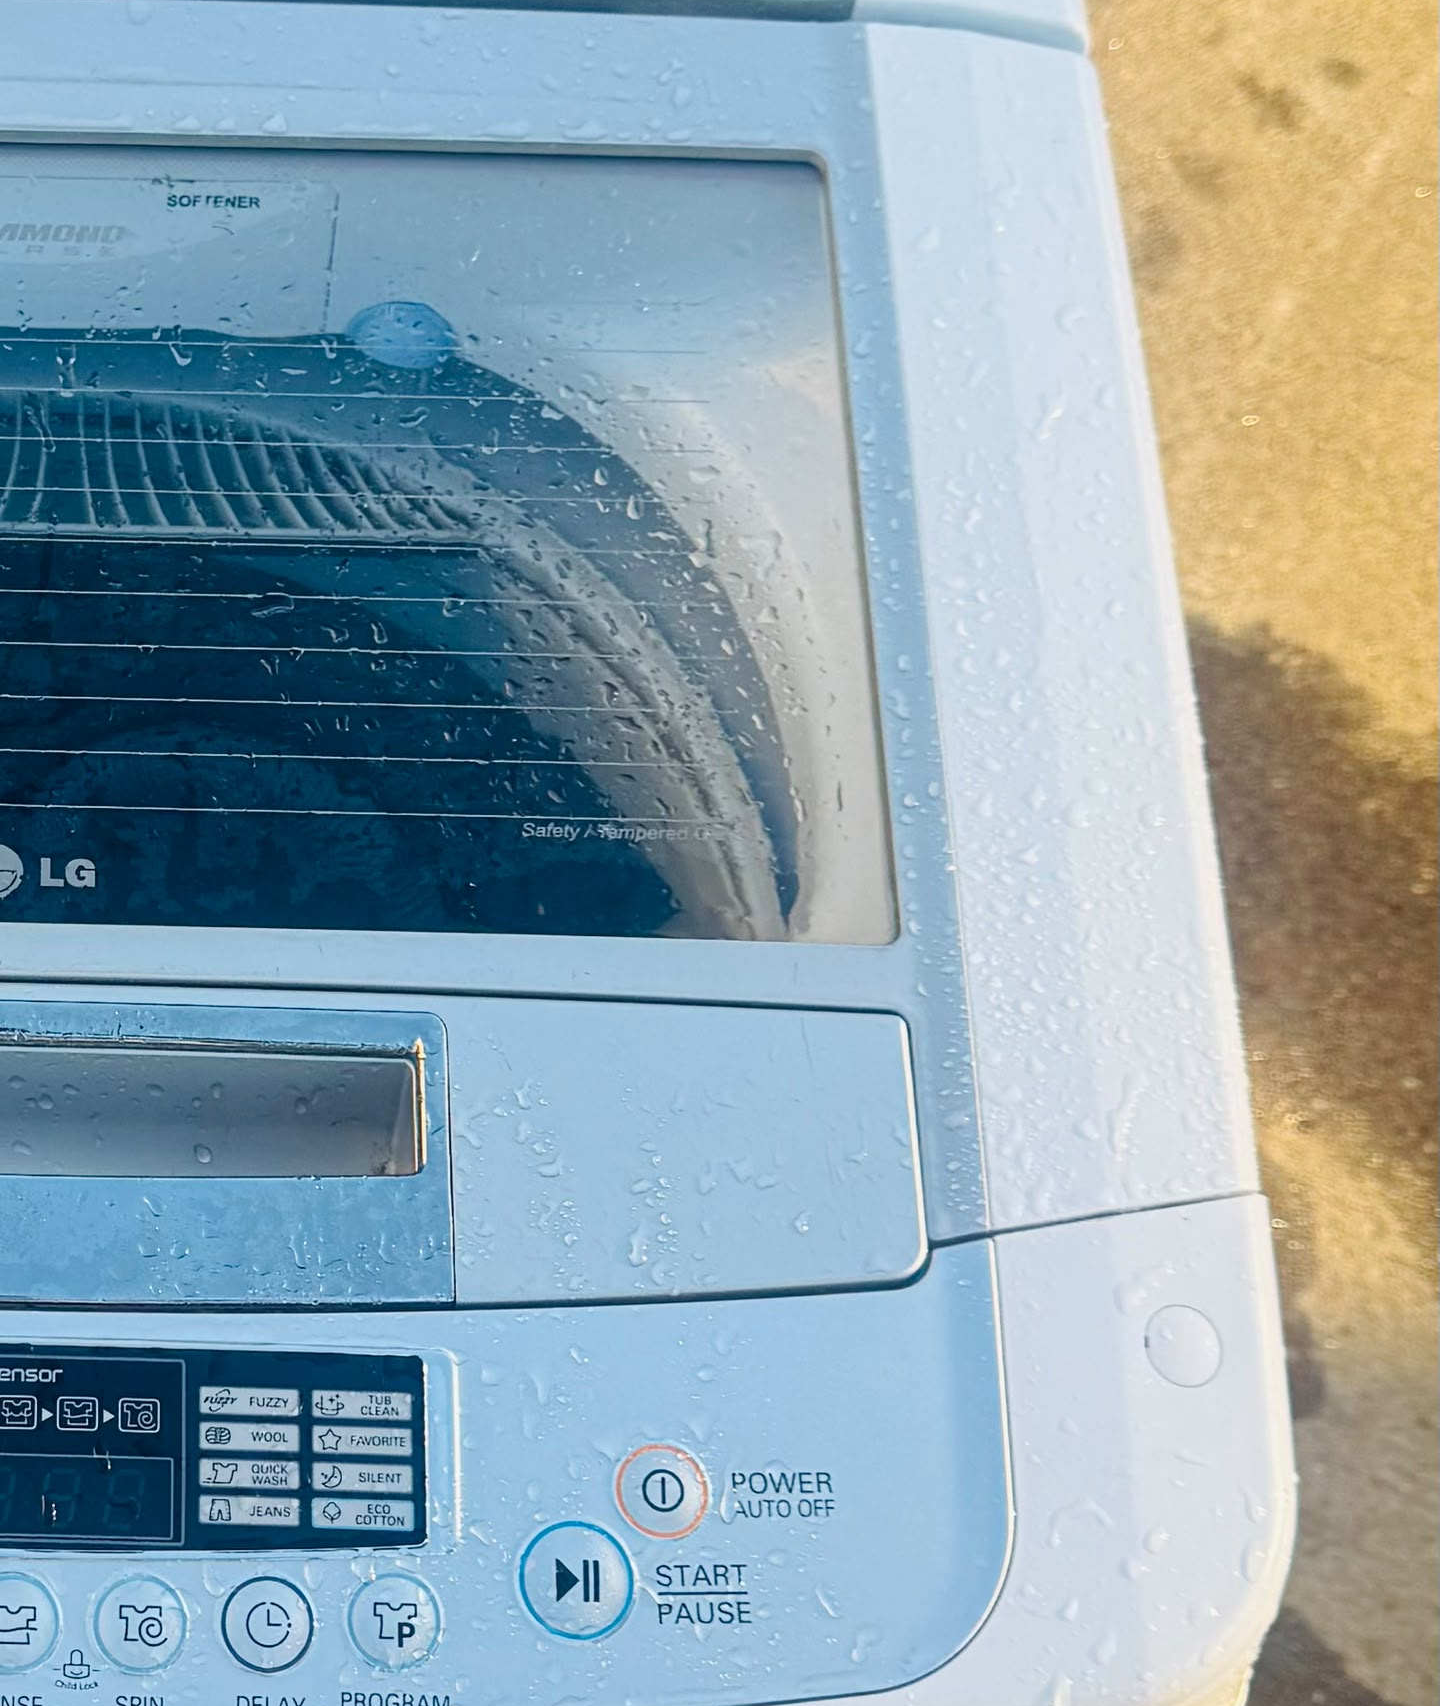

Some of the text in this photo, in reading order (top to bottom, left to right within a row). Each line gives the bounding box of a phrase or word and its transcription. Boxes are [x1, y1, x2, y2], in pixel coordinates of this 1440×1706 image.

[166, 194, 260, 209] SOFTENER
[521, 822, 580, 841] Safety
[40, 857, 96, 888] LG
[249, 1397, 288, 1409] FUZZY
[368, 1394, 392, 1406] TUB
[360, 1406, 400, 1417] CLEAN
[251, 1431, 407, 1448] WOOL FAVORITE
[251, 1464, 402, 1484] QUICK SILENT
[251, 1475, 288, 1486] WASH
[732, 1472, 833, 1494] POWER
[249, 1503, 391, 1518] JEANS ECO
[736, 1499, 836, 1518] AUTO OFF
[355, 1514, 405, 1527] COTTON
[655, 1564, 748, 1587] START
[658, 1602, 753, 1624] PAUSE
[55, 1680, 98, 1690] Child Lock
